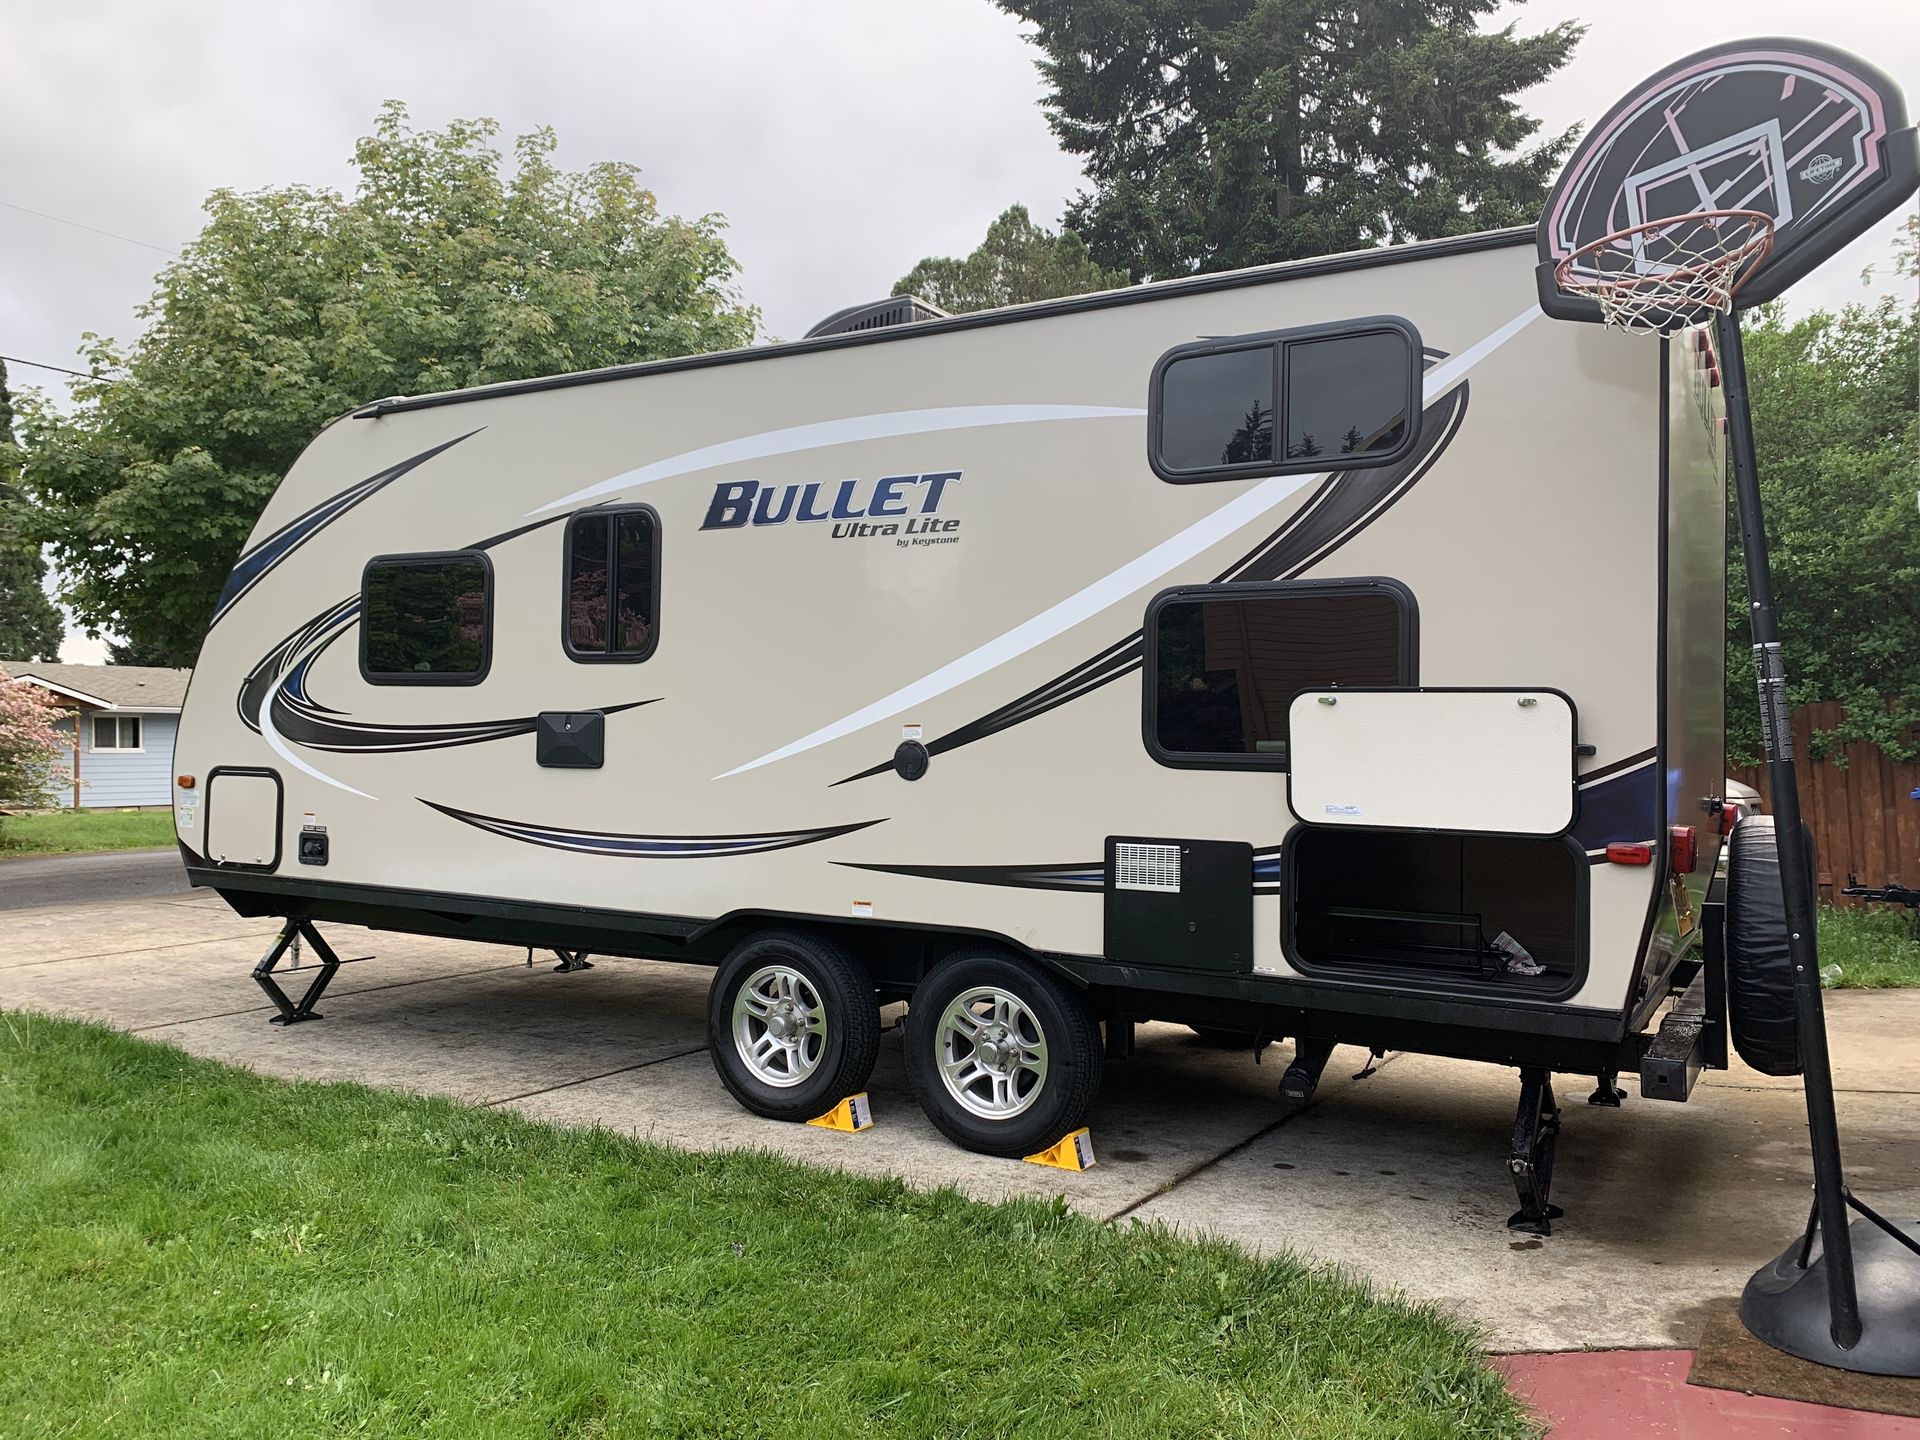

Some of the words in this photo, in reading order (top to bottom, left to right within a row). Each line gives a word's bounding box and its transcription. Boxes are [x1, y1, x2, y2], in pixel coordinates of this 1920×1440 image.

[1803, 160, 1838, 177] LIFETIME
[698, 469, 964, 531] BULLET
[831, 522, 899, 539] Ultra
[905, 517, 961, 535] Lite
[896, 538, 909, 548] by
[912, 536, 960, 547] Keystone
